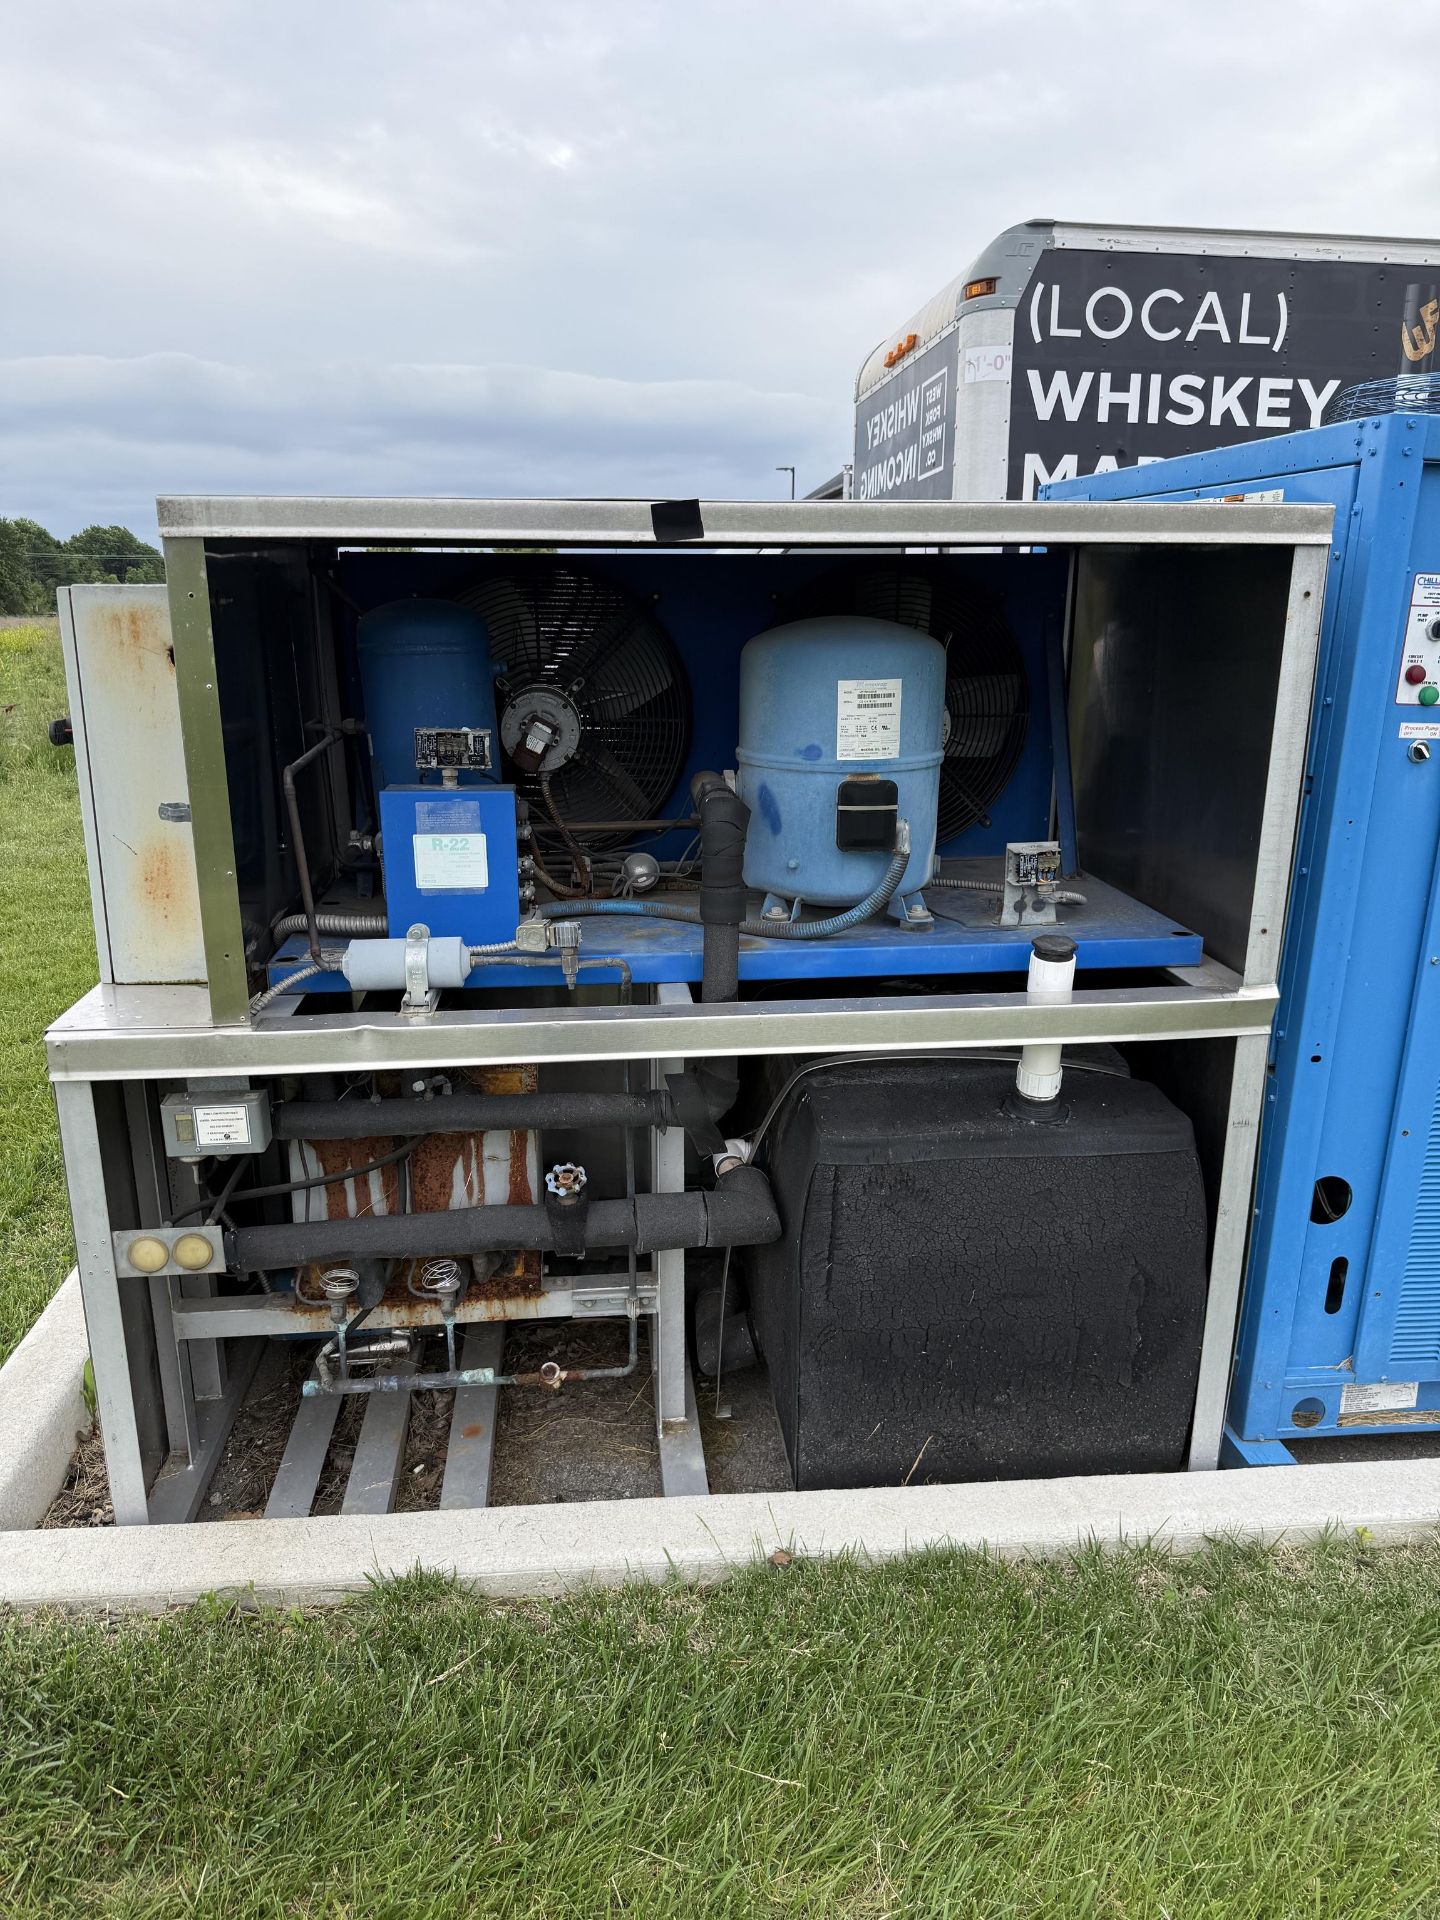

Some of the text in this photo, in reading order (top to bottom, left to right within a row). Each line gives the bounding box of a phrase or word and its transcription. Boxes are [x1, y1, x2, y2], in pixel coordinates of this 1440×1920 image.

[1030, 282, 1288, 353] (LOCAL)
[1026, 369, 1342, 428] WHISKEY
[431, 837, 471, 851] R-22
